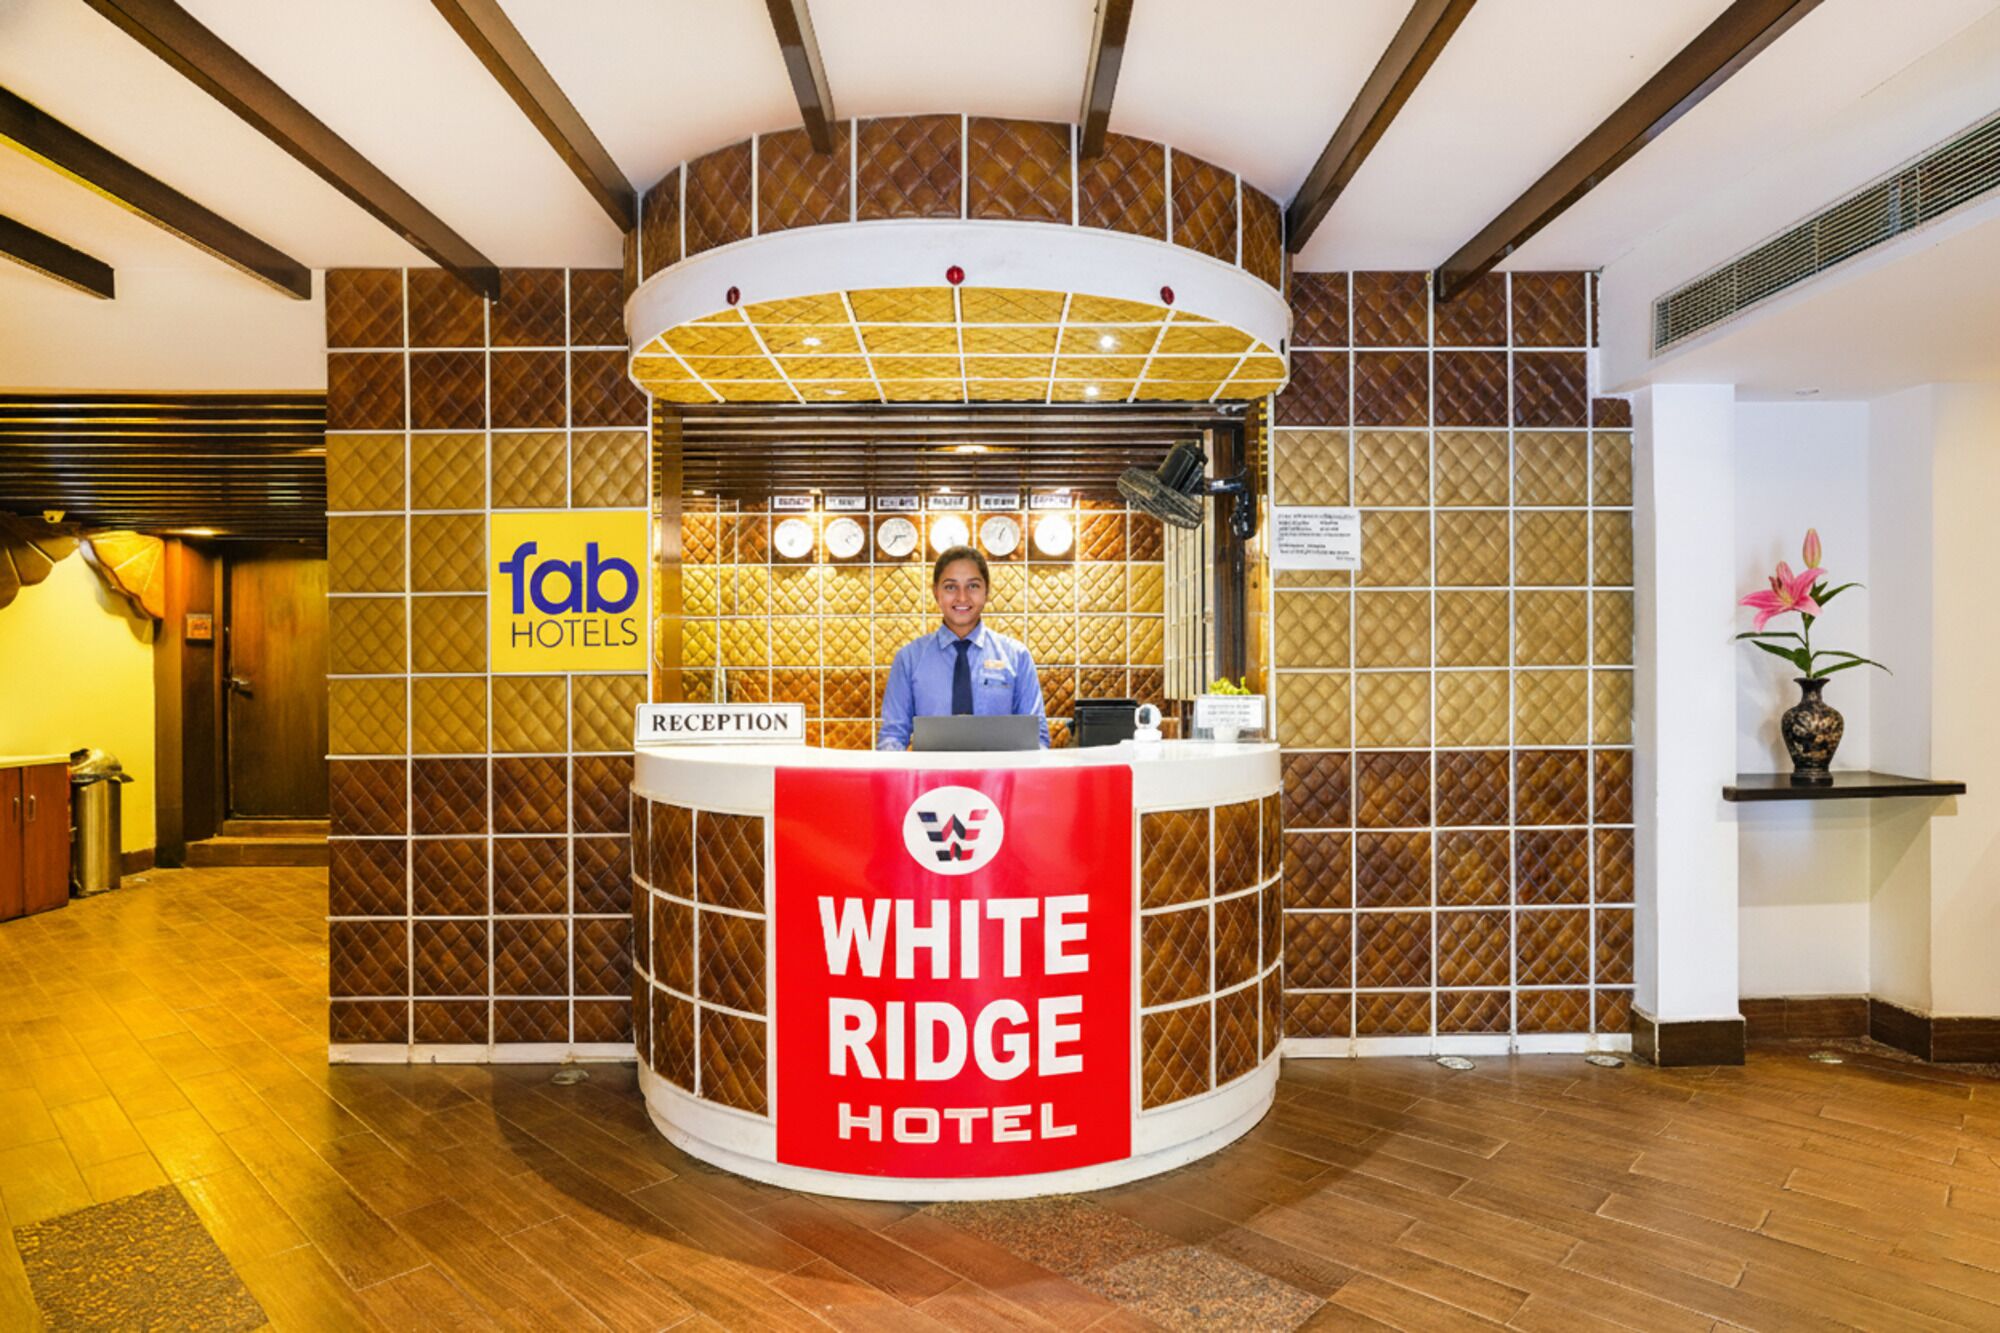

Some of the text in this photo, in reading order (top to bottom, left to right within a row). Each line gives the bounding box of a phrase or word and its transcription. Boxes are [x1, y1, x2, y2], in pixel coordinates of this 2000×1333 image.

[499, 541, 638, 615] fab
[512, 617, 638, 648] HOTELS
[653, 713, 788, 732] RECEPTION
[818, 894, 1089, 979] WHITE
[829, 995, 1083, 1081] RIDGE
[838, 1102, 1078, 1144] HOTEL
